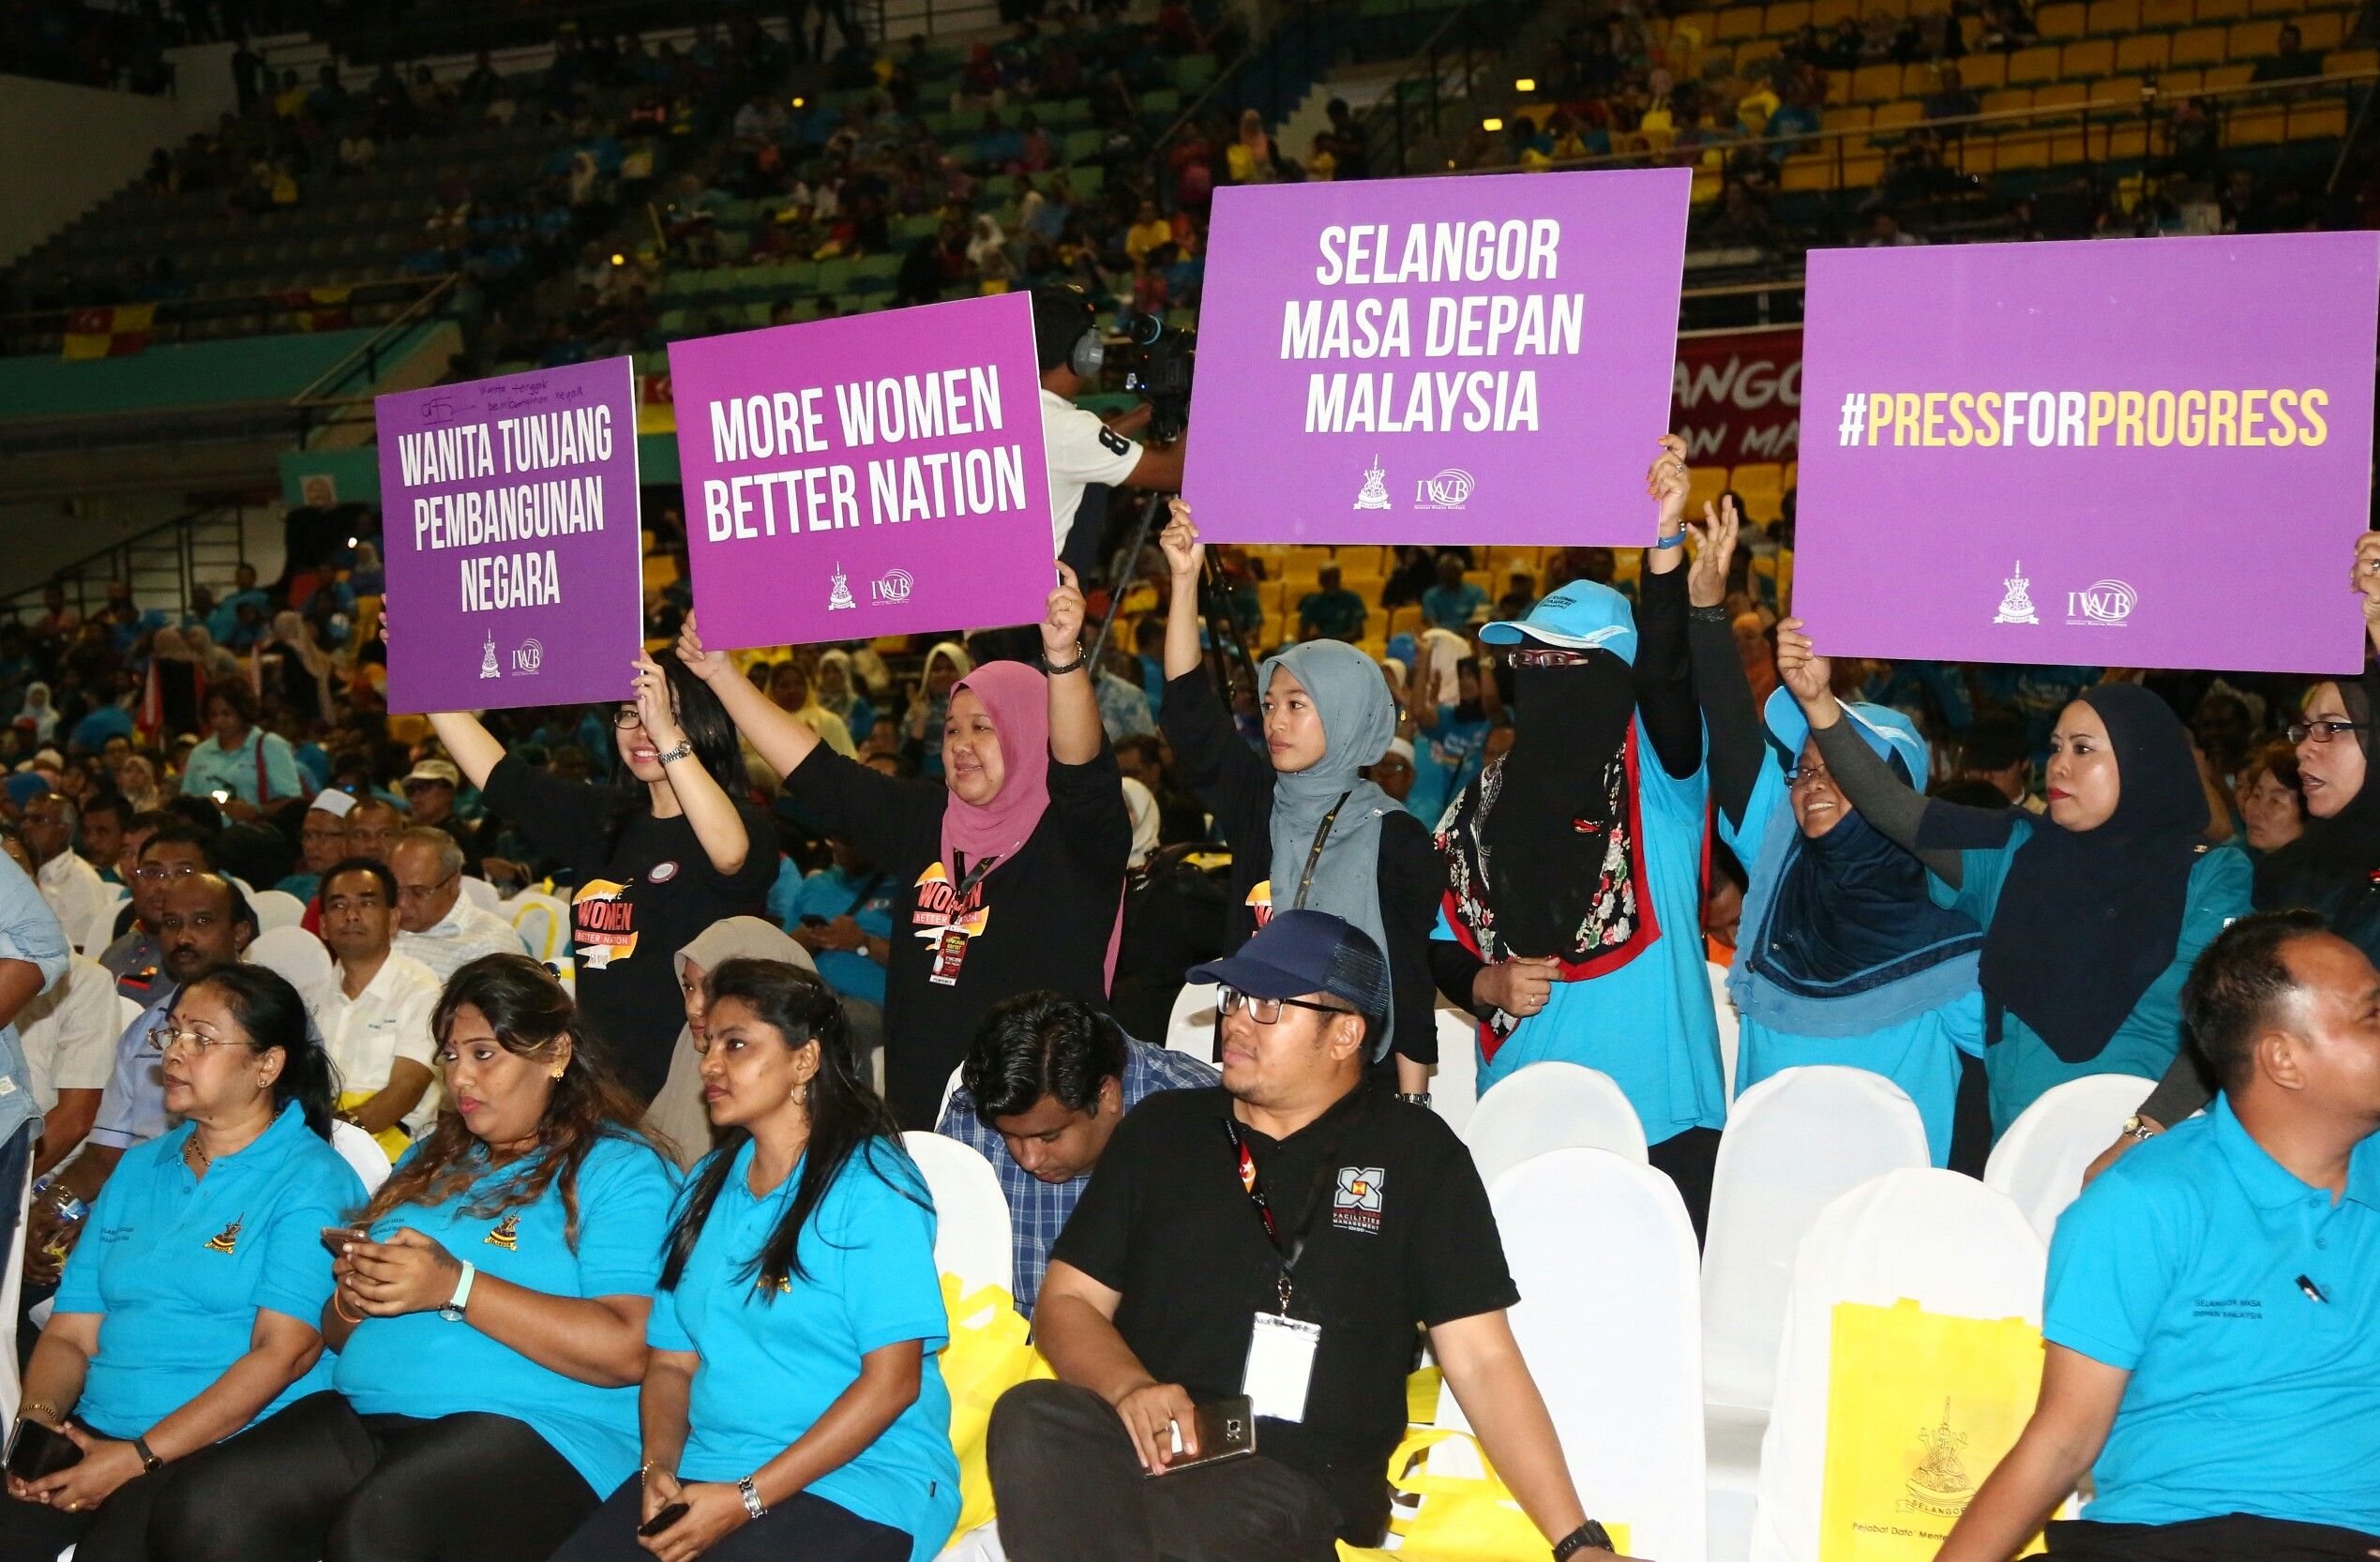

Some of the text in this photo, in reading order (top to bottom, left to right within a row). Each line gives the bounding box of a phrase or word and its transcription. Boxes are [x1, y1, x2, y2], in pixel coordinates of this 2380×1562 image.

[1316, 218, 1560, 286] SELANGOR
[1280, 293, 1585, 359] MASA DEPAN
[710, 365, 1003, 463] MORE WOMEN
[1304, 370, 1539, 433] MALAYSIA
[1839, 388, 2329, 447] #PRESSFORPROGRESS
[399, 423, 495, 487] WANITA
[498, 404, 612, 473] TUNJANG
[703, 444, 1027, 542] BETTER NATION
[1415, 479, 1469, 503] IWB
[414, 475, 604, 550] PEMBANGUNAN
[460, 550, 561, 612] NEGARA
[870, 577, 911, 600] IWB
[2067, 592, 2131, 617] IWB
[511, 648, 540, 669] IWB
[578, 900, 634, 931] WOMEN
[916, 913, 947, 924] BETTER
[577, 932, 600, 943] BETTER
[1333, 1212, 1380, 1225] FACILITIES
[1333, 1219, 1379, 1231] MANAGEMENT
[1852, 1522, 1948, 1542] Pejabat Dato' Mente
